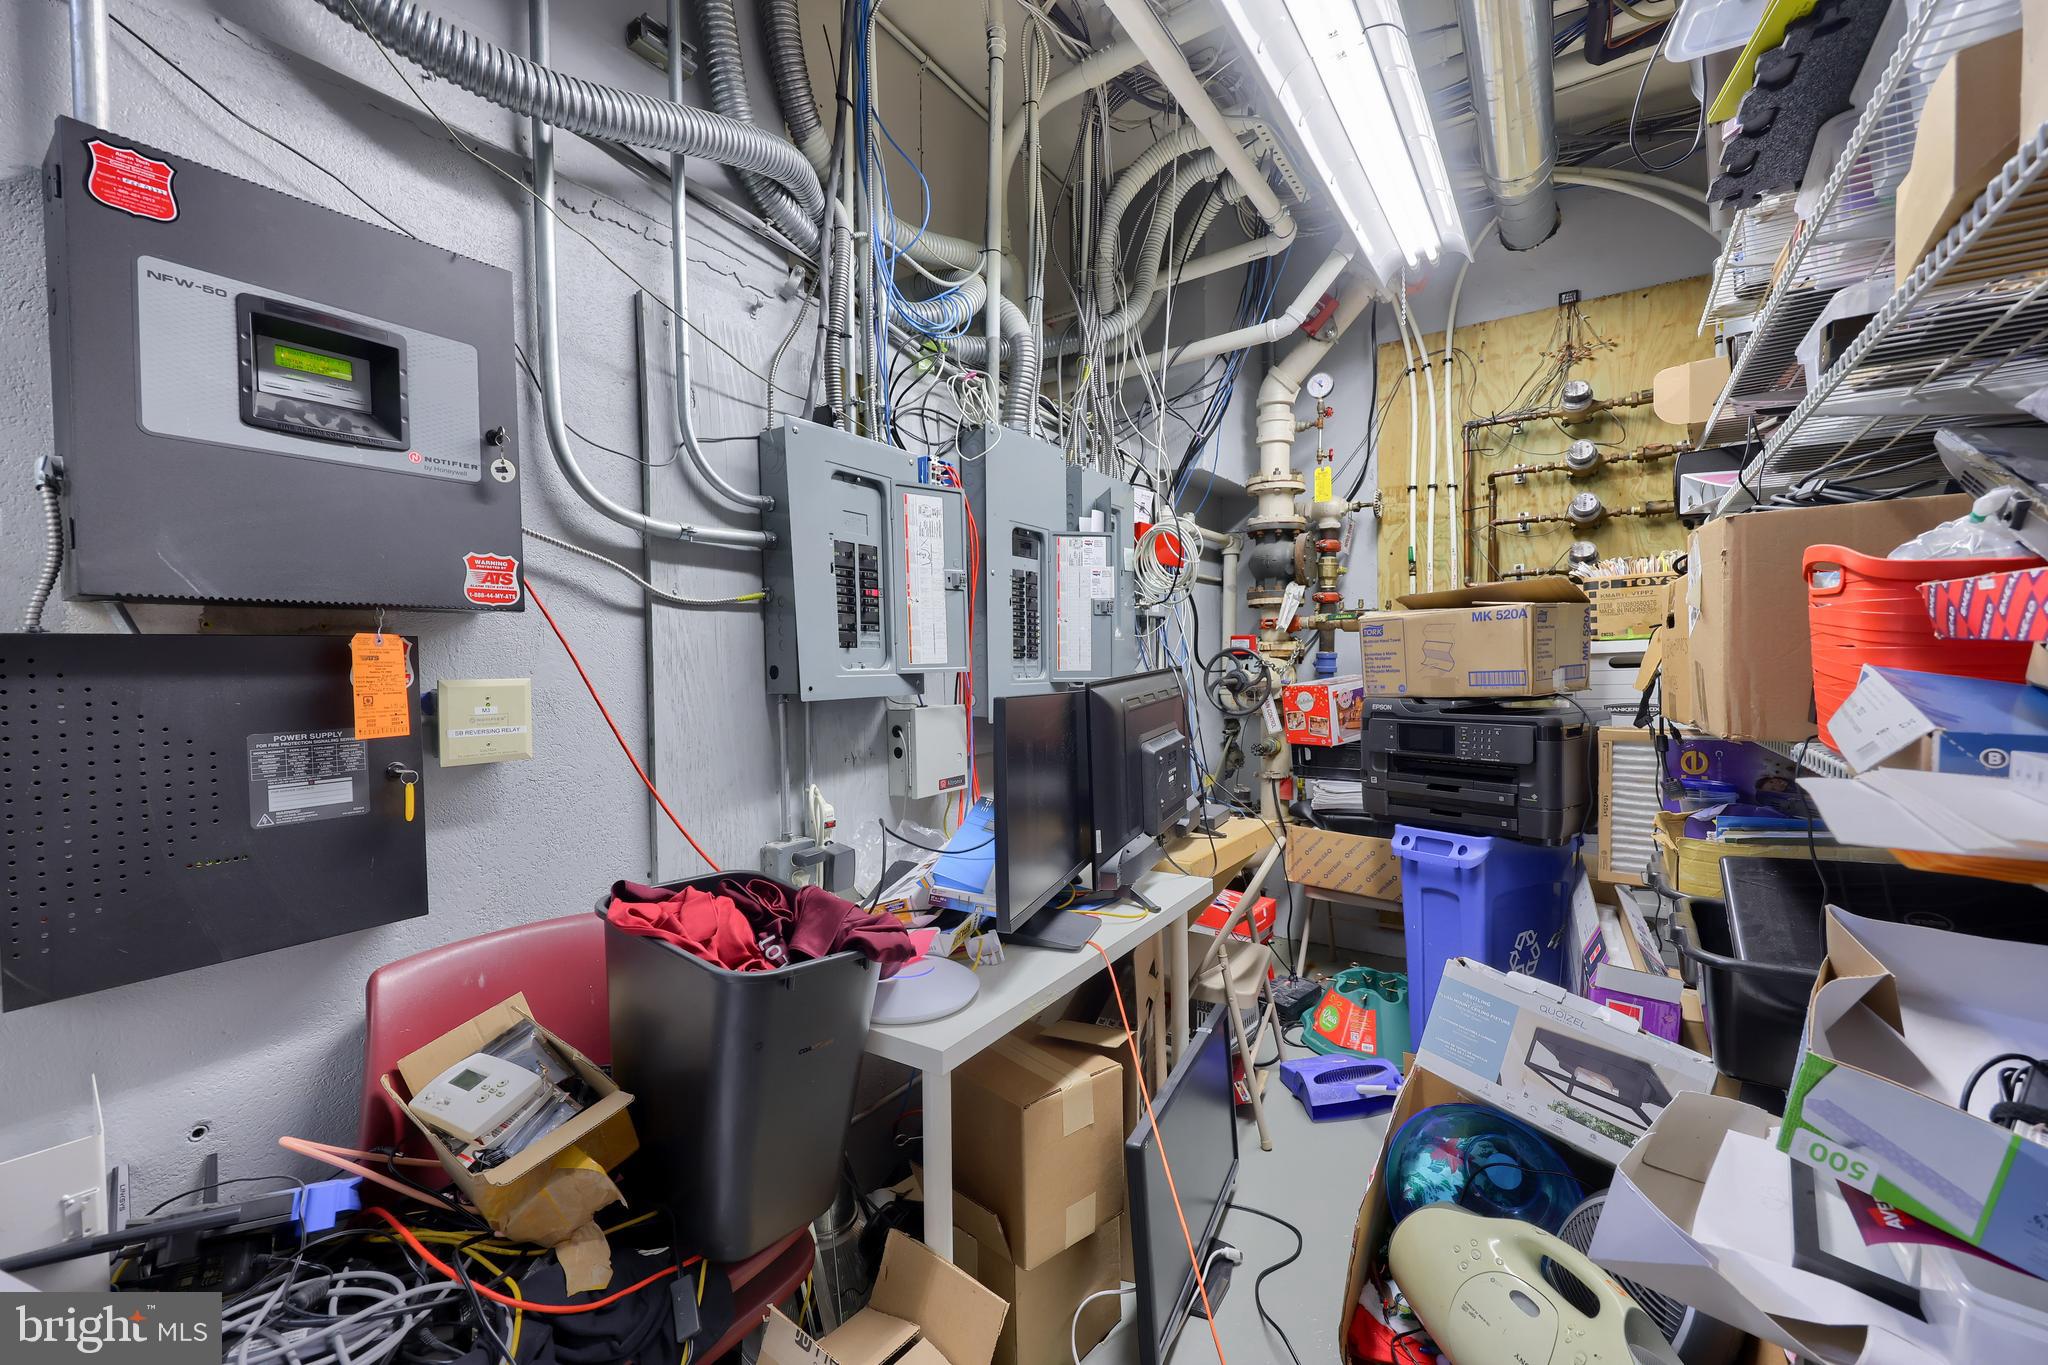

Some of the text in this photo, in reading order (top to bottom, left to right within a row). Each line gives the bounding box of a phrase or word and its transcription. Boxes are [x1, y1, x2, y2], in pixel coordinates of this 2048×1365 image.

[146, 270, 228, 298] NFW-50
[424, 456, 478, 470] NOTIFIER
[434, 465, 468, 476] Honeywell
[481, 572, 514, 585] ATS
[1472, 608, 1528, 622] MK 520A
[1582, 641, 1589, 660] MK
[274, 731, 343, 742] POWER SUPPLY
[1540, 1004, 1586, 1030] QUOIZEL
[1808, 1142, 1869, 1181] 500
